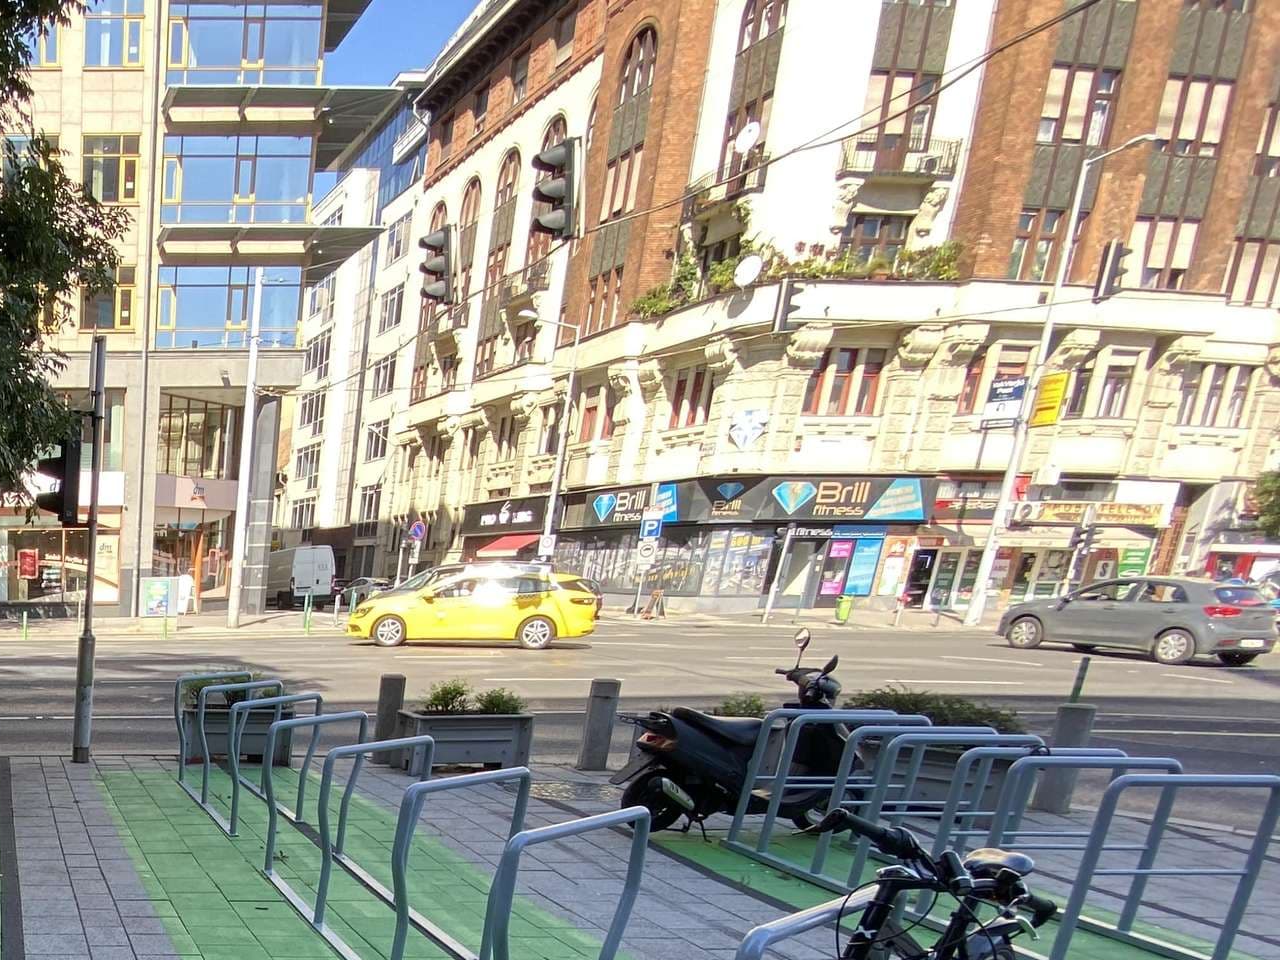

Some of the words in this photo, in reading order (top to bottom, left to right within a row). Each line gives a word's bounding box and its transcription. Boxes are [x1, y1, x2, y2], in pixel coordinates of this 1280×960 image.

[614, 490, 646, 512] Brill
[815, 481, 871, 504] Brill
[812, 504, 865, 516] fitness
[643, 520, 659, 537] P
